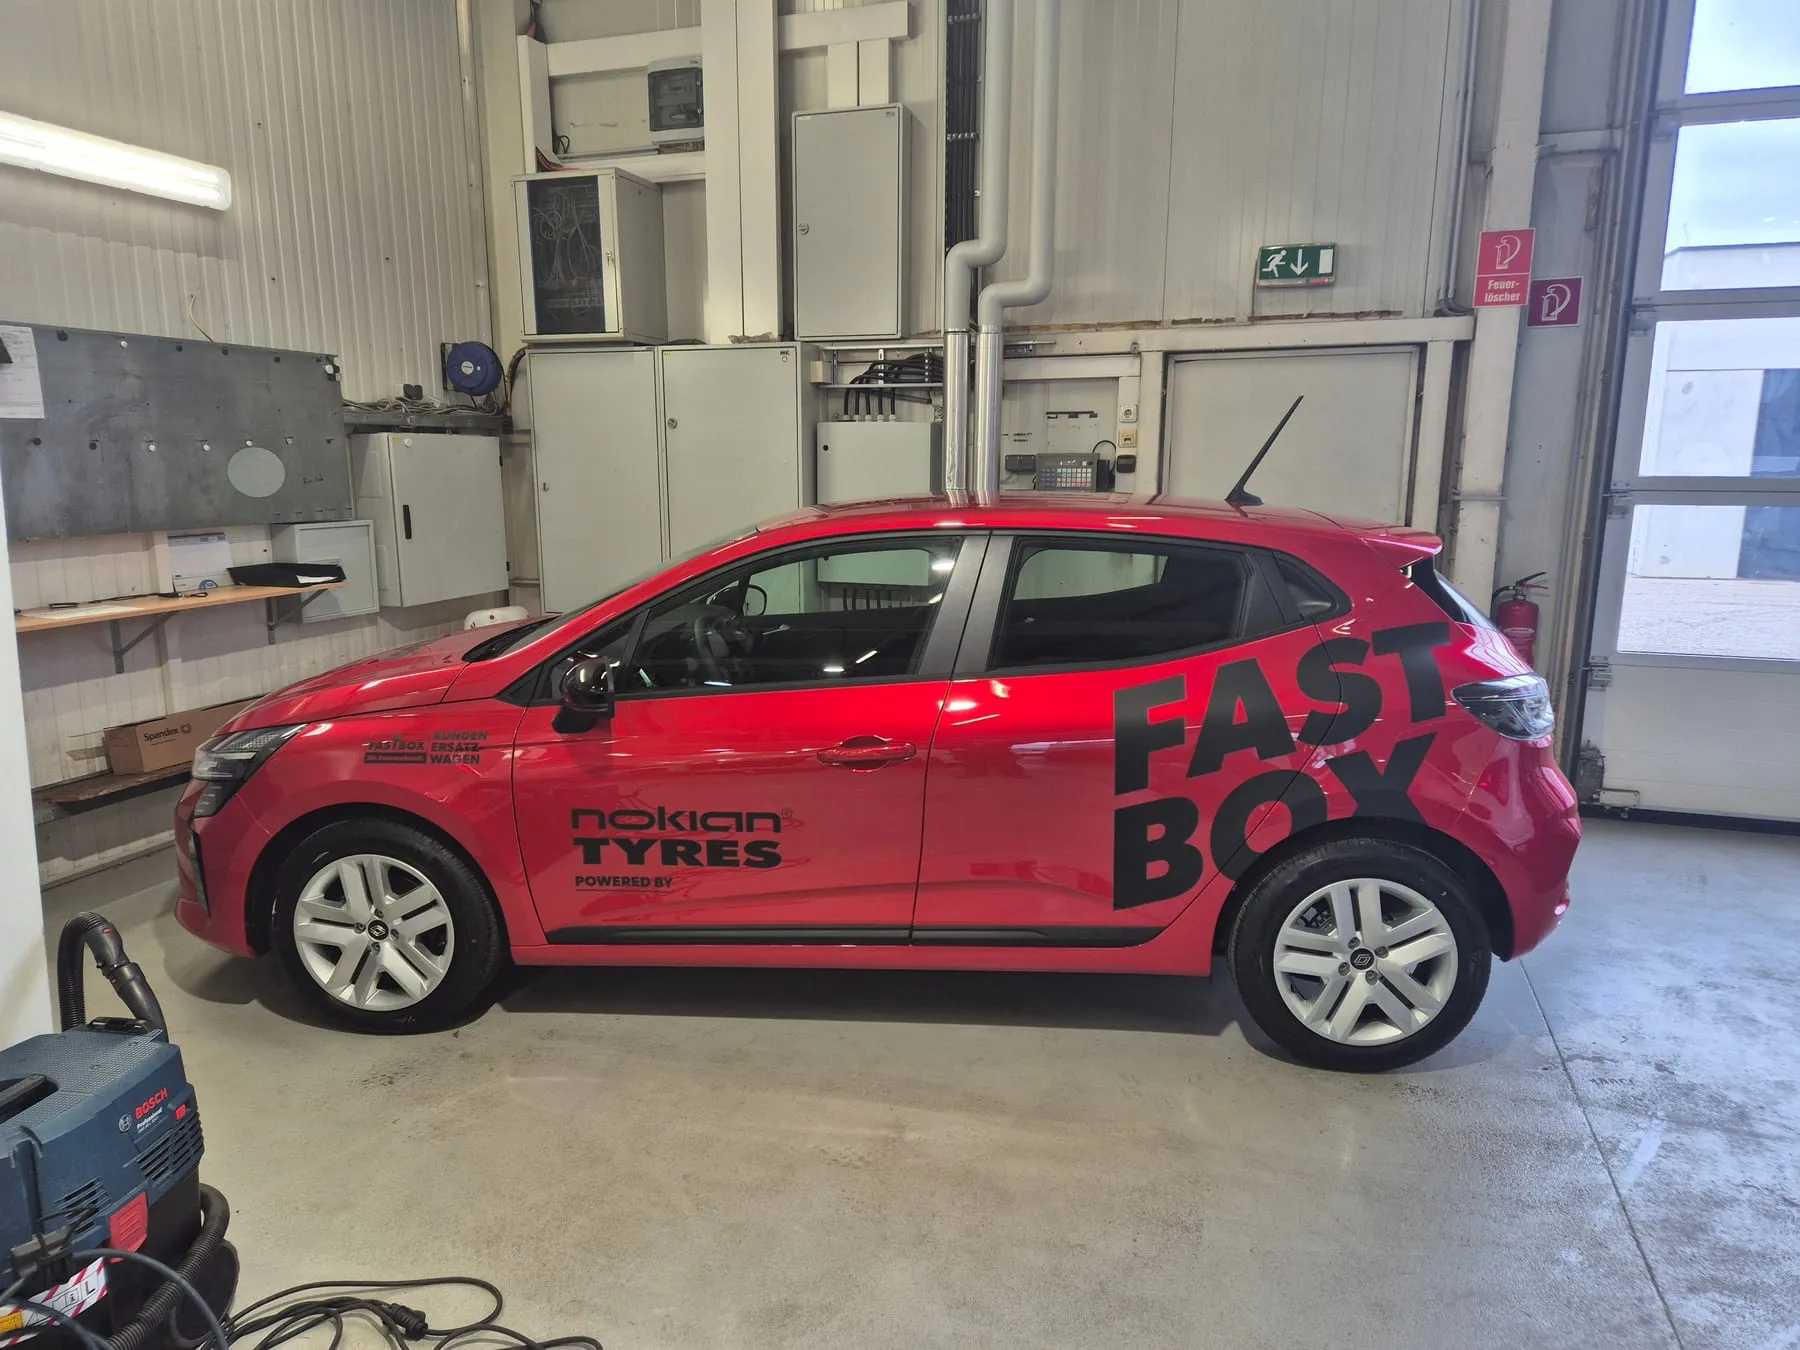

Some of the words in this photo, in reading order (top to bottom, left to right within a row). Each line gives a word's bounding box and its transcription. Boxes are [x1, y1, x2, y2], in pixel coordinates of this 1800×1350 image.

[1487, 279, 1520, 290] Feuer-
[1484, 292, 1521, 303] löscher
[1113, 621, 1452, 796] FAST
[143, 728, 179, 742] Spandex
[430, 755, 480, 764] WAGEN
[1113, 732, 1438, 912] BOX
[573, 838, 782, 869] TYRES
[575, 875, 650, 888] POWERED
[654, 877, 673, 888] BY
[135, 1087, 168, 1119] BOSCH
